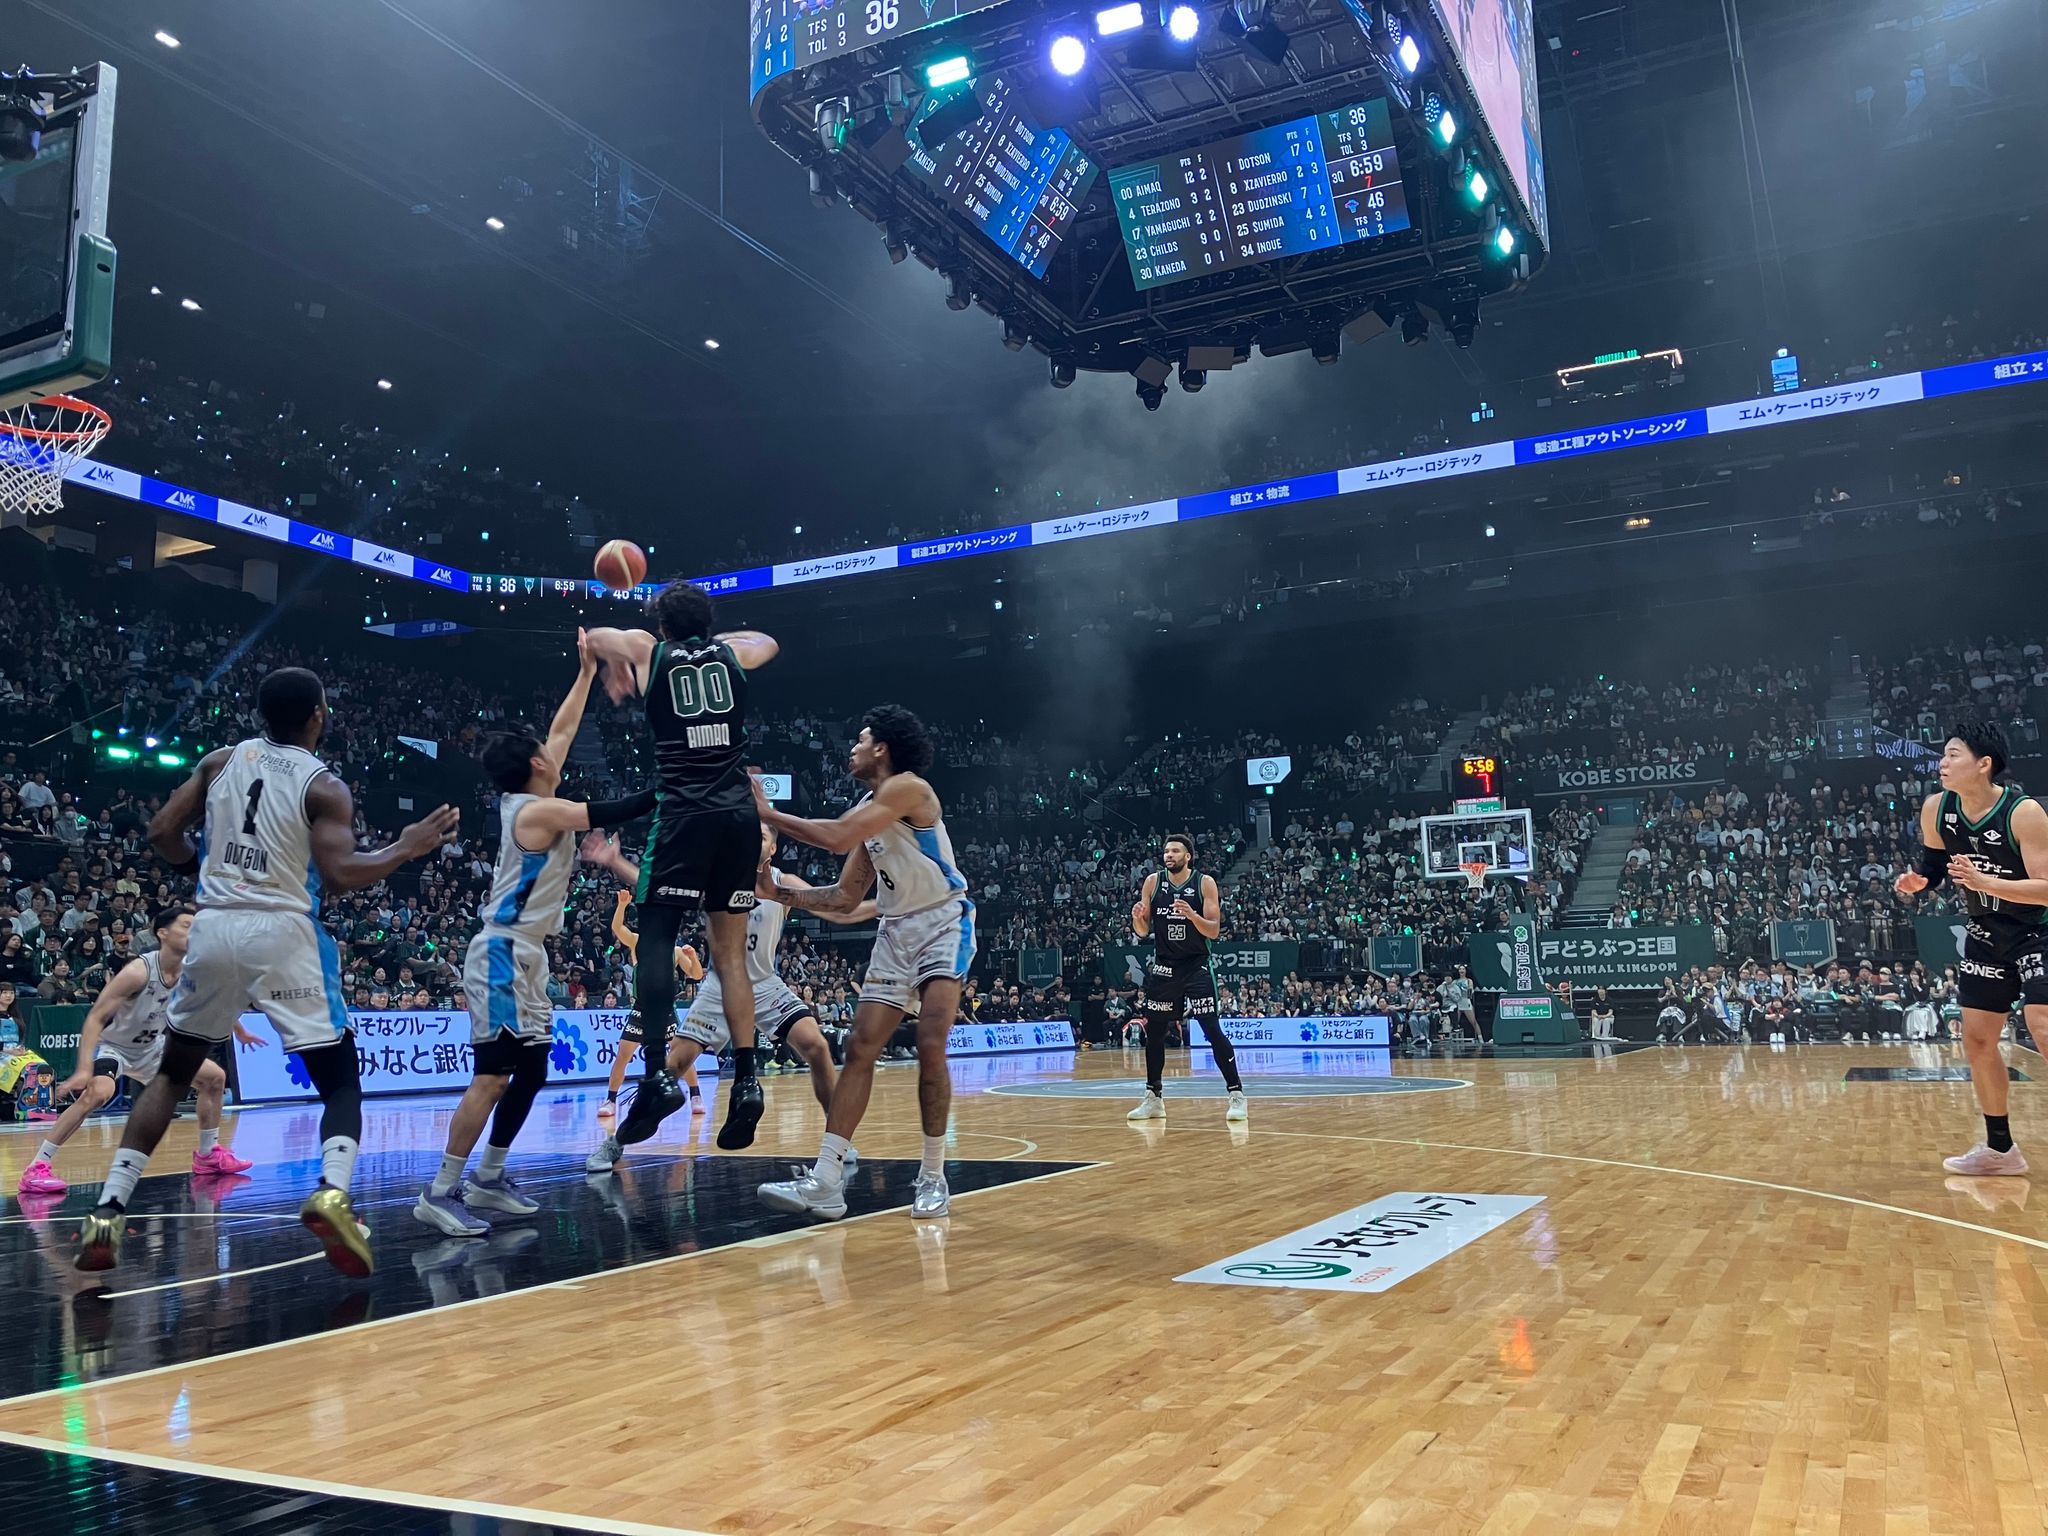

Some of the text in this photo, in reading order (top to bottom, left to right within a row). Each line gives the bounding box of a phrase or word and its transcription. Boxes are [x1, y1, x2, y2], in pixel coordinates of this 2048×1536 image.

[765, 8, 772, 27] 7
[808, 12, 845, 36] TFS 0
[866, 0, 900, 35] 36
[765, 33, 771, 51] 4
[780, 24, 787, 43] 2
[808, 31, 846, 55] TOL 3
[765, 50, 786, 76] 0 1
[987, 93, 1003, 113] 12 2
[984, 122, 992, 133] 2
[1349, 107, 1366, 125] 36
[966, 135, 974, 147] 2
[973, 142, 982, 153] 2
[1009, 116, 1055, 165] 1 DOTSON 17 0
[1286, 131, 1298, 140] PTS
[1338, 127, 1364, 143] TFS 0
[998, 135, 1045, 184] 8 2 3
[1227, 140, 1313, 173] 1 DOTSON 17 0
[1340, 140, 1367, 156] TOL 3
[963, 162, 971, 173] 0
[1076, 158, 1088, 176] 36
[1180, 154, 1202, 167] PTS F
[1332, 154, 1383, 184] 3Q 6:59
[944, 175, 953, 186] 0
[953, 183, 960, 193] 1
[986, 154, 997, 167] 23
[1021, 186, 1029, 196] 7
[1120, 168, 1207, 200] 00 AIMAQ 12 2
[1230, 162, 1318, 194] 8 XZAVIERRO 2 3
[1365, 176, 1372, 188] 7
[975, 174, 986, 187] 25
[1011, 206, 1018, 216] 4
[1018, 212, 1025, 222] 2
[1049, 196, 1069, 221] 6:59
[1129, 189, 1211, 219] 4 TERAZONO 3 2
[1232, 184, 1321, 216] 23 DUDZINSKI 7 1
[1368, 192, 1384, 209] 46
[965, 193, 976, 208] 34
[1001, 224, 1008, 235] 0
[1132, 210, 1216, 240] 17 YAMAGUCHI 2 2
[1237, 205, 1326, 236] 25 SUMIDA 4 2
[1355, 211, 1382, 226] TFS 3
[1038, 232, 1050, 249] 46
[1241, 226, 1330, 257] 34 INOUE 0 1
[1357, 224, 1384, 238] TOL 2
[1033, 249, 1040, 258] 3
[1135, 230, 1220, 260] 23 CHILDS 9 0
[1027, 260, 1034, 270] 2
[1140, 250, 1224, 280] 30 KANEDA 0 1
[1994, 362, 2028, 380] 組立
[1738, 385, 1881, 421] エム・ケー・ロジテック
[1533, 417, 1688, 455] 製造工程アウトソーシング
[1366, 453, 1482, 483] エム・ケー・ロジテック
[1230, 484, 1290, 507] 組立 物流
[1052, 508, 1150, 535] エム・ケー・ロジテック
[911, 530, 1018, 560] 製造工程アウトソーシング
[793, 554, 877, 578] エム・ケー・ロジテック
[500, 578, 516, 593] 36
[668, 662, 734, 717] 00
[686, 723, 730, 748] AIMAQ
[1477, 773, 1490, 792] 7
[1558, 763, 1696, 787] KOBE STORKS
[242, 778, 264, 836] 1
[880, 870, 894, 890] 8
[1168, 924, 1186, 940] 23
[1564, 962, 1677, 975] ANIMAL KINGDOM
[1960, 961, 2005, 979] SONEC
[1148, 1002, 1173, 1011] SONEC
[40, 1034, 67, 1048] KOBE
[133, 1029, 159, 1044] 25
[1226, 1030, 1273, 1040] みなと銀行
[1323, 1029, 1374, 1040] みなと銀行
[1287, 1195, 1476, 1258] りそなグループ
